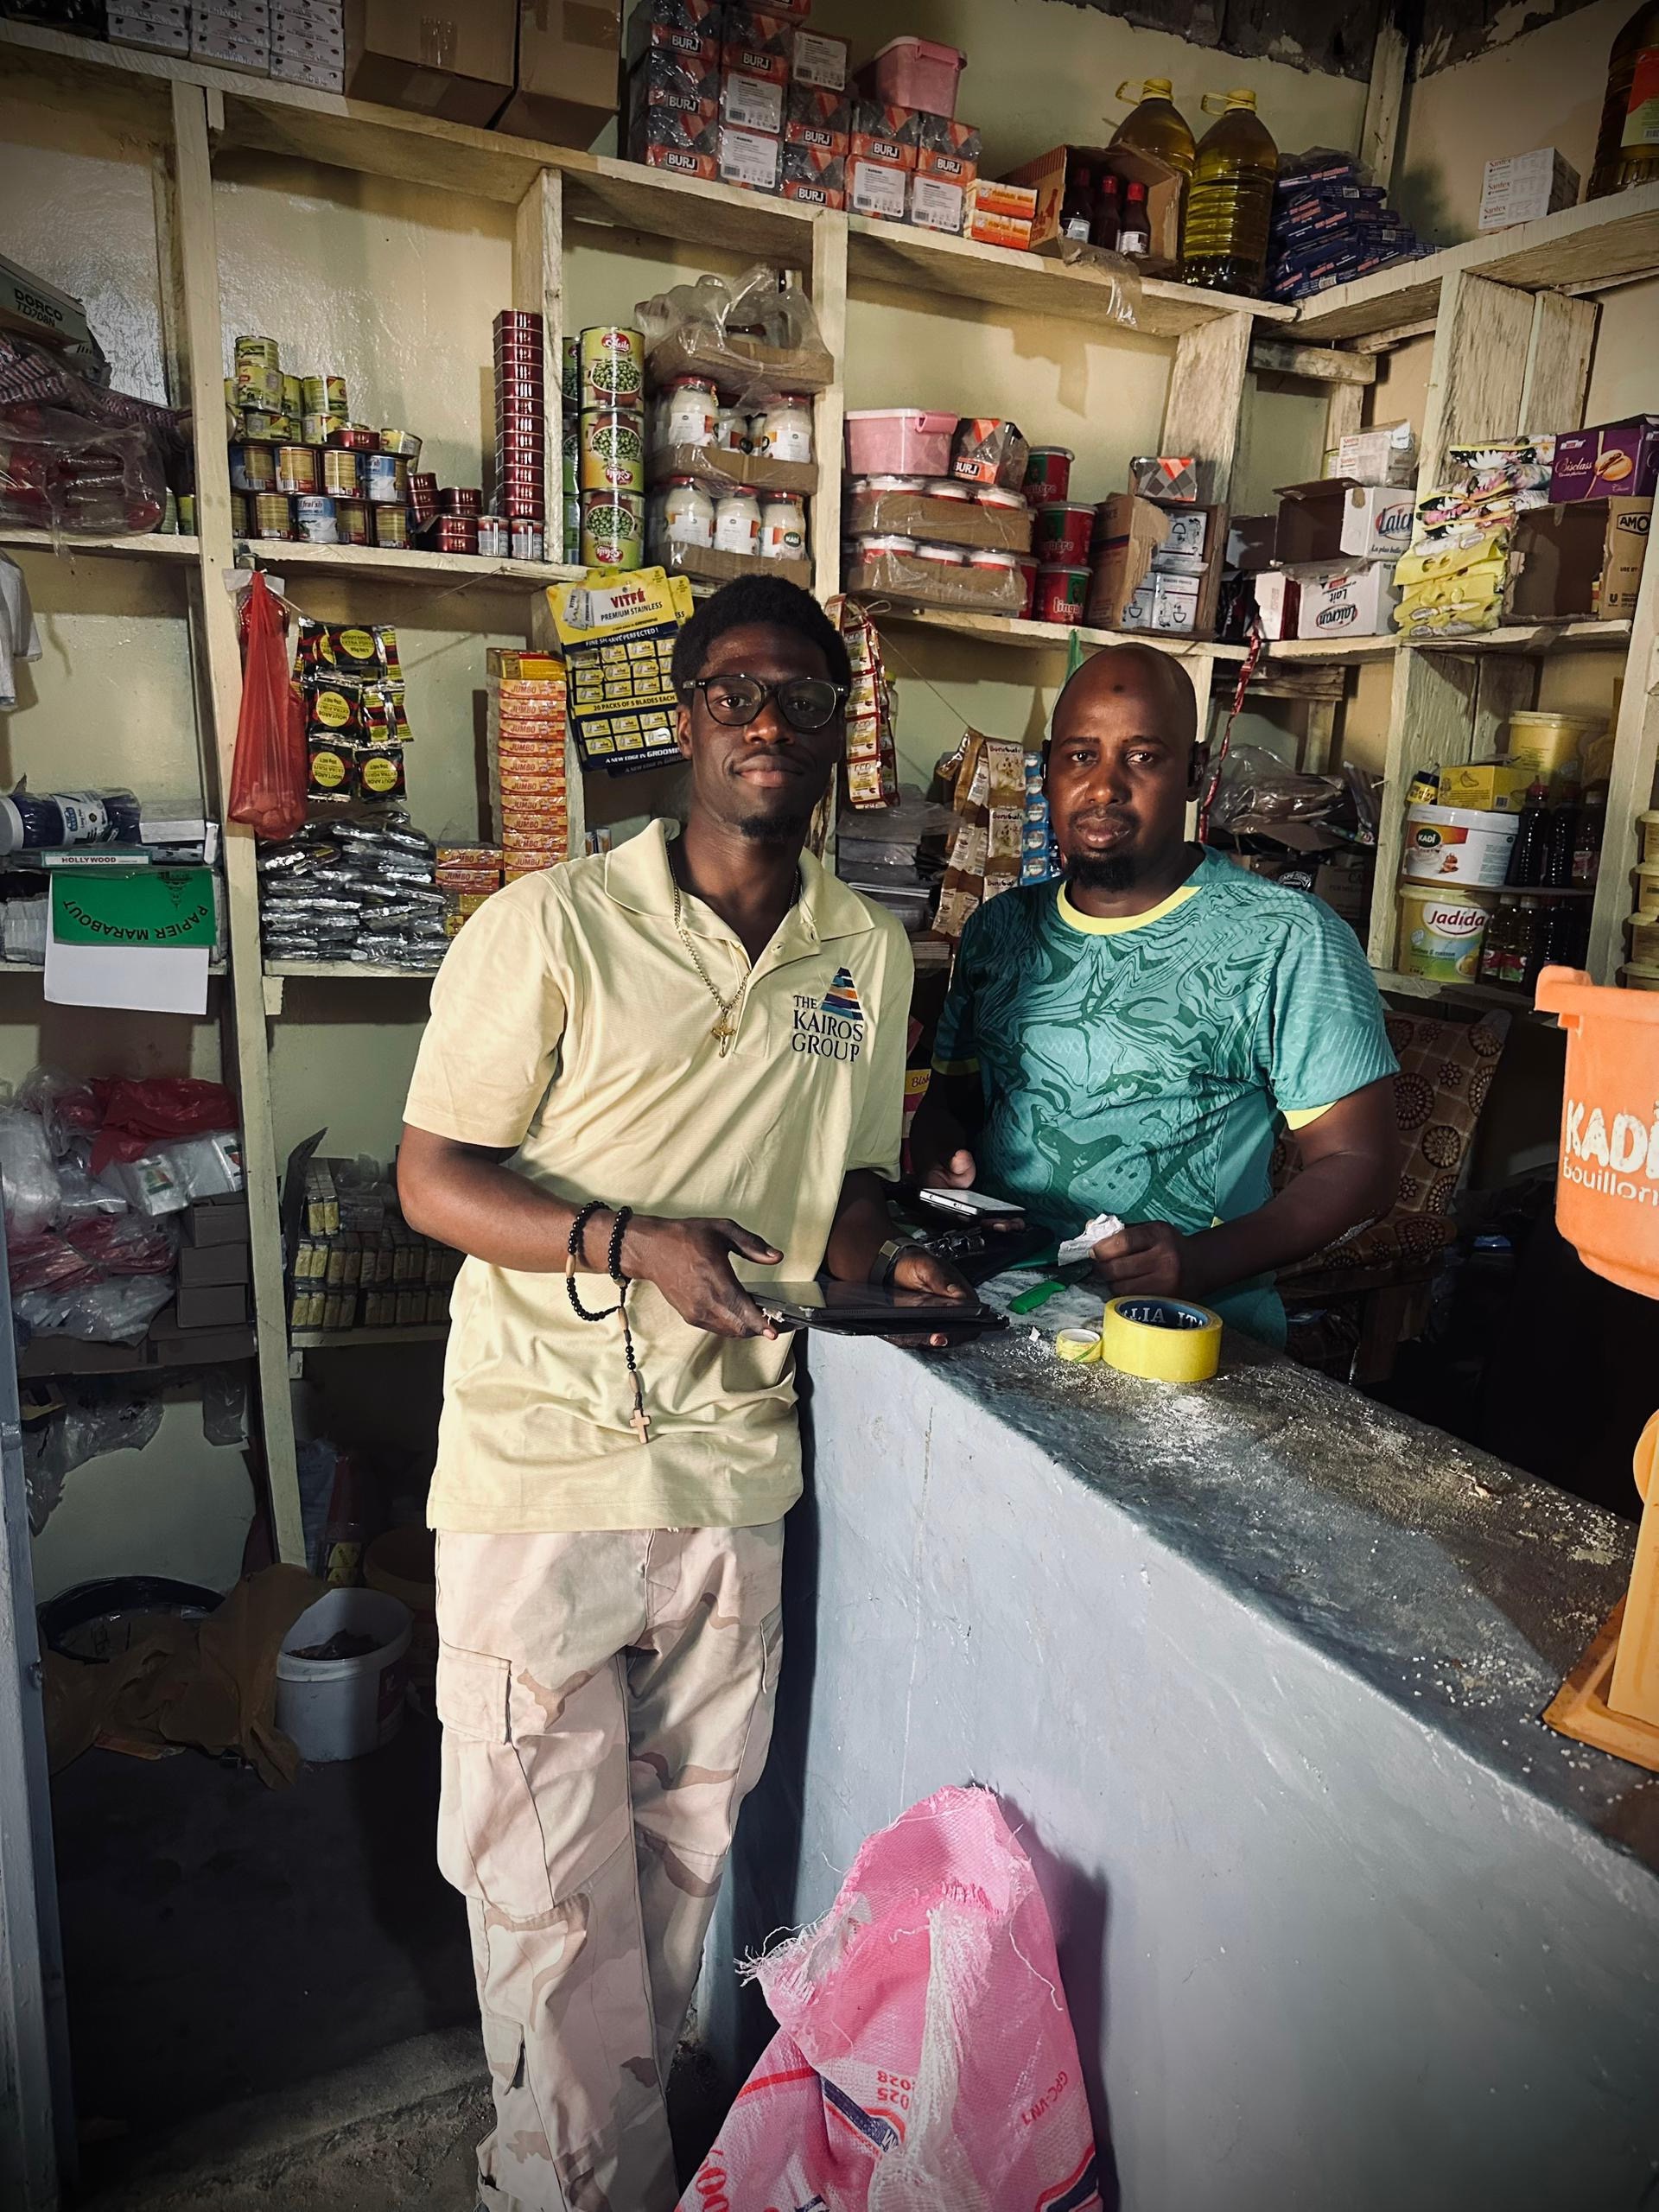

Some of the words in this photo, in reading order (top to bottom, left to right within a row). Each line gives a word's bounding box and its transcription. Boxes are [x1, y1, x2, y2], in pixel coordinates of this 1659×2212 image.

[672, 35, 699, 51] BURJ
[743, 53, 769, 70] BURJ
[669, 96, 696, 111] BURJ
[805, 131, 830, 145] BURJ
[874, 143, 898, 157] BURJ
[669, 154, 696, 168] BURJ
[937, 158, 961, 174] BURJ
[798, 188, 824, 202] BURJ
[14, 288, 63, 321] DORCO
[1329, 588, 1347, 604] Lait
[601, 608, 630, 621] PREMIUM
[631, 601, 663, 614] STAINLESS
[1319, 604, 1357, 626] Laicran
[636, 697, 658, 706] BLADES
[63, 899, 149, 940] MARABOUT
[156, 905, 208, 939] PAPIER
[793, 995, 817, 1009] THE
[793, 1009, 864, 1042] KAIROS
[792, 1033, 860, 1062] GROUP
[877, 2070, 912, 2091] 028
